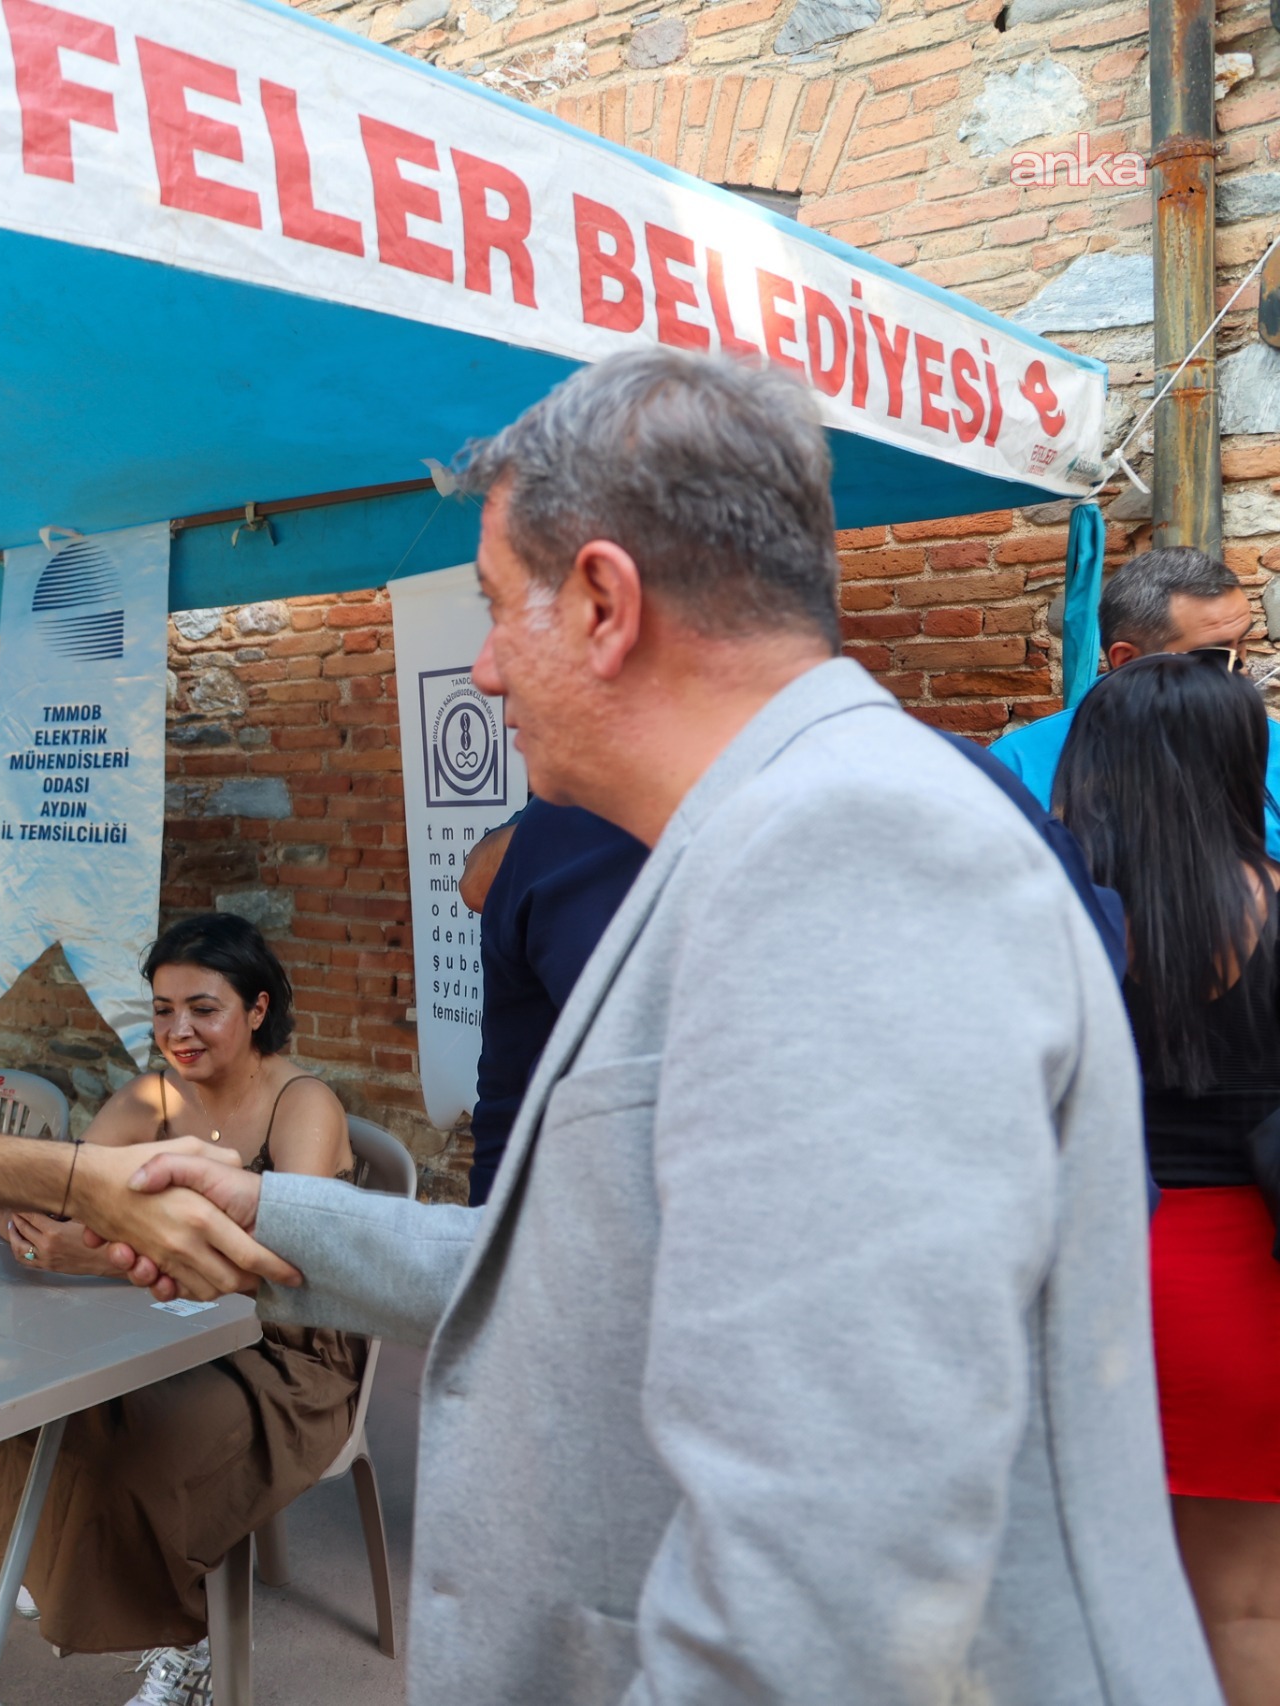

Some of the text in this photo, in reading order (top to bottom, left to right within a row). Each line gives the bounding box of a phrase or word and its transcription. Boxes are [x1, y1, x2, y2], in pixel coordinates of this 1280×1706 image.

[573, 192, 1004, 448] BELEDİYESİ
[43, 704, 102, 723] TMMOB
[34, 724, 108, 746] ELEKTRİK
[9, 747, 129, 770] MÜHENDİSLERİ
[43, 776, 90, 794] ODASI
[40, 800, 87, 818] AYDIN
[1, 820, 128, 844] İL TEMSİLCİLİĞİ
